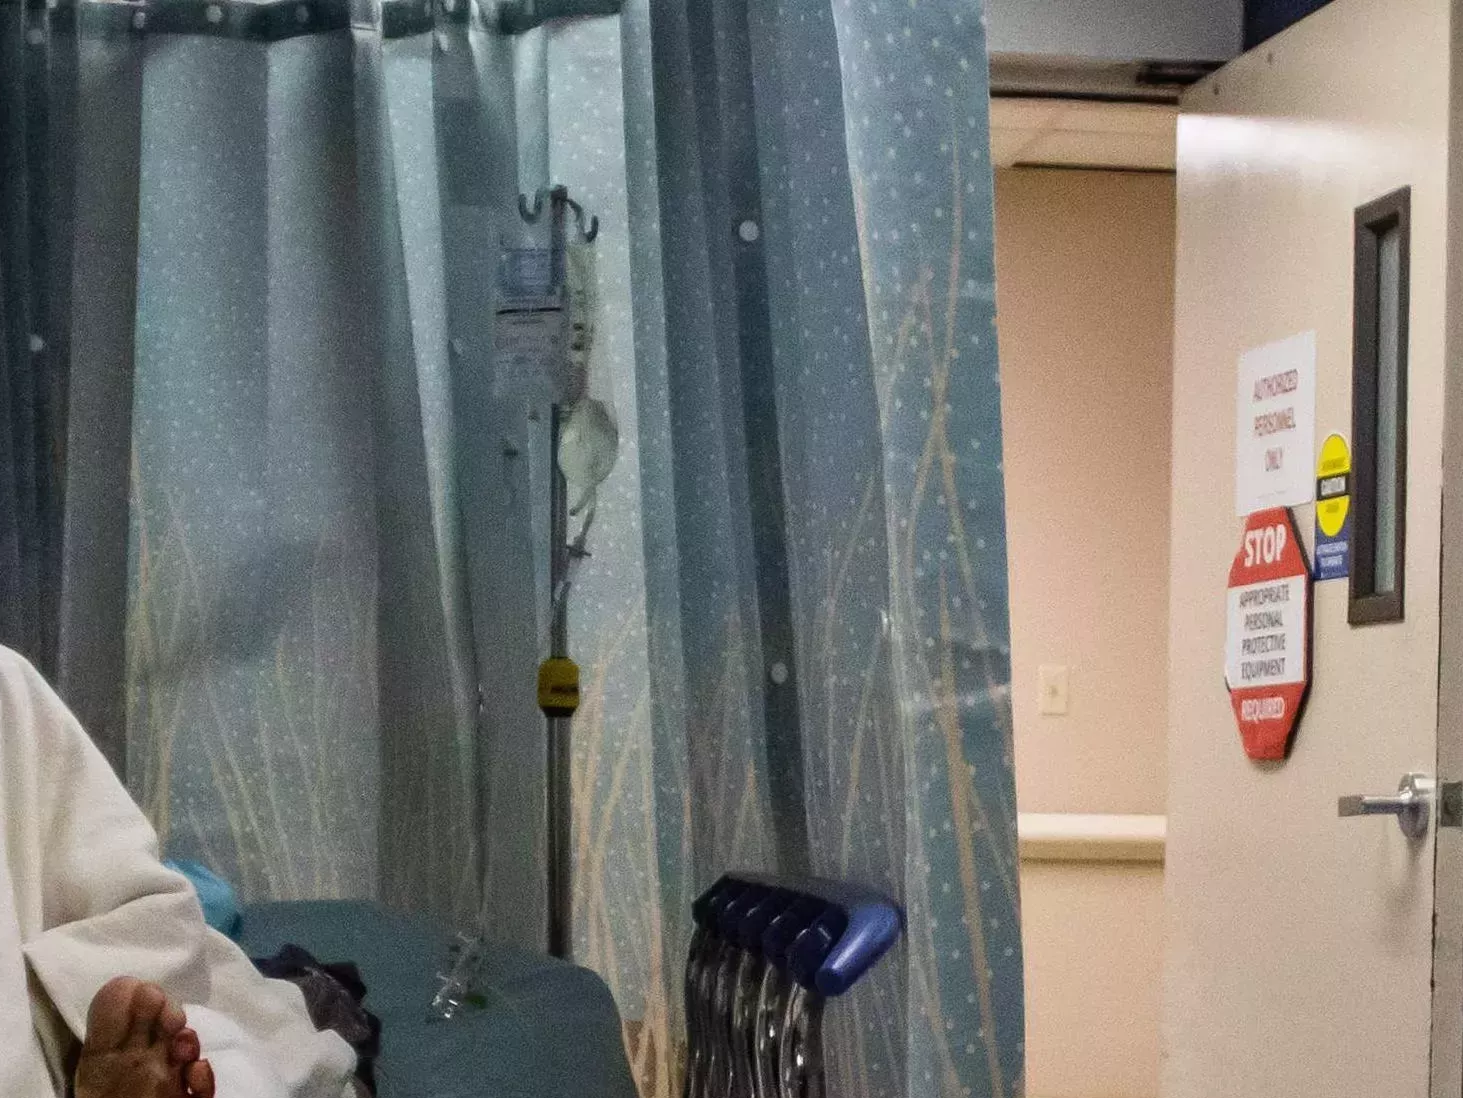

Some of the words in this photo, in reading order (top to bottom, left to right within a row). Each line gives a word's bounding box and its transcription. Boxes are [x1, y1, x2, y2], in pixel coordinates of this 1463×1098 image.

[1244, 524, 1287, 568] STOP
[1239, 583, 1290, 608] APPROPRIATE
[1243, 610, 1284, 631] PERSONAL
[1241, 633, 1287, 656] PROTECTIVE
[1240, 657, 1286, 681] EQUIPMENT
[1241, 697, 1285, 724] REQUIRED
